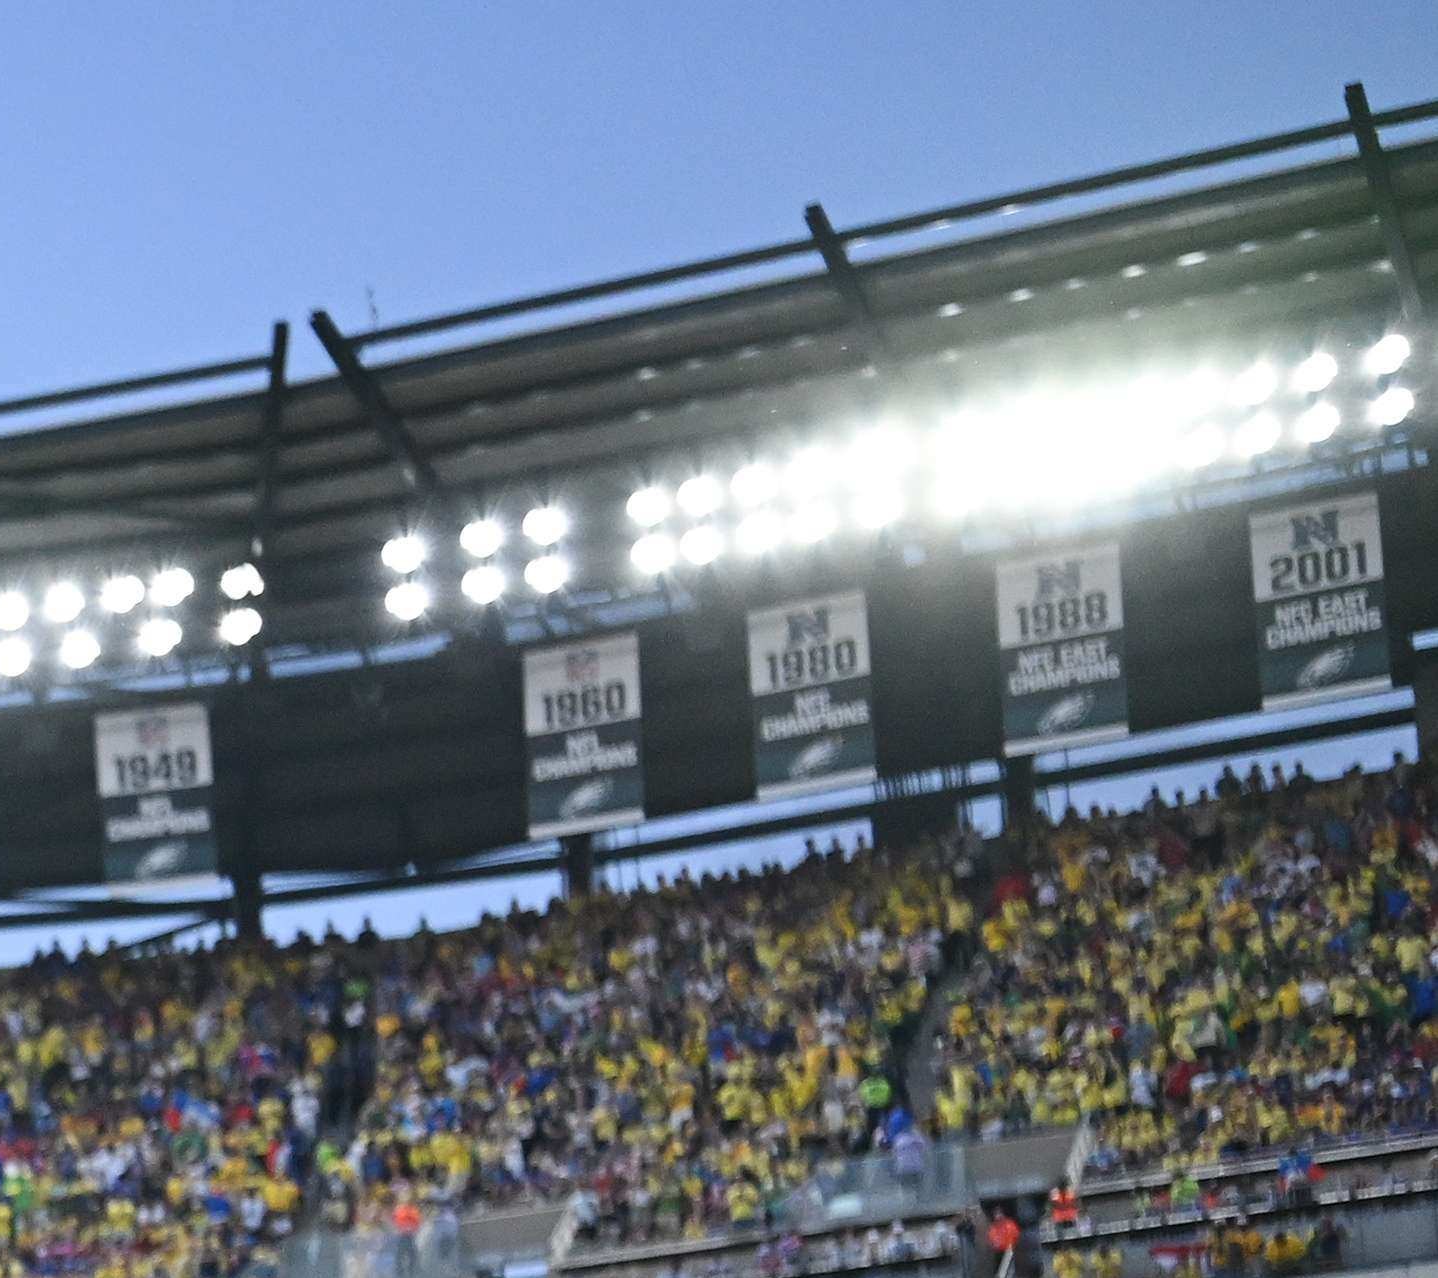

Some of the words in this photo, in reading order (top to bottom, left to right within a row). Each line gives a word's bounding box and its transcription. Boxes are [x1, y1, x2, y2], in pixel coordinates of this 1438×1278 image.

[1270, 541, 1369, 594] 2001
[1015, 591, 1108, 641] 1988
[1266, 607, 1382, 650] CHAMPIONS
[765, 639, 858, 688] 1980
[542, 680, 627, 730] 1960
[113, 748, 198, 789] 1949
